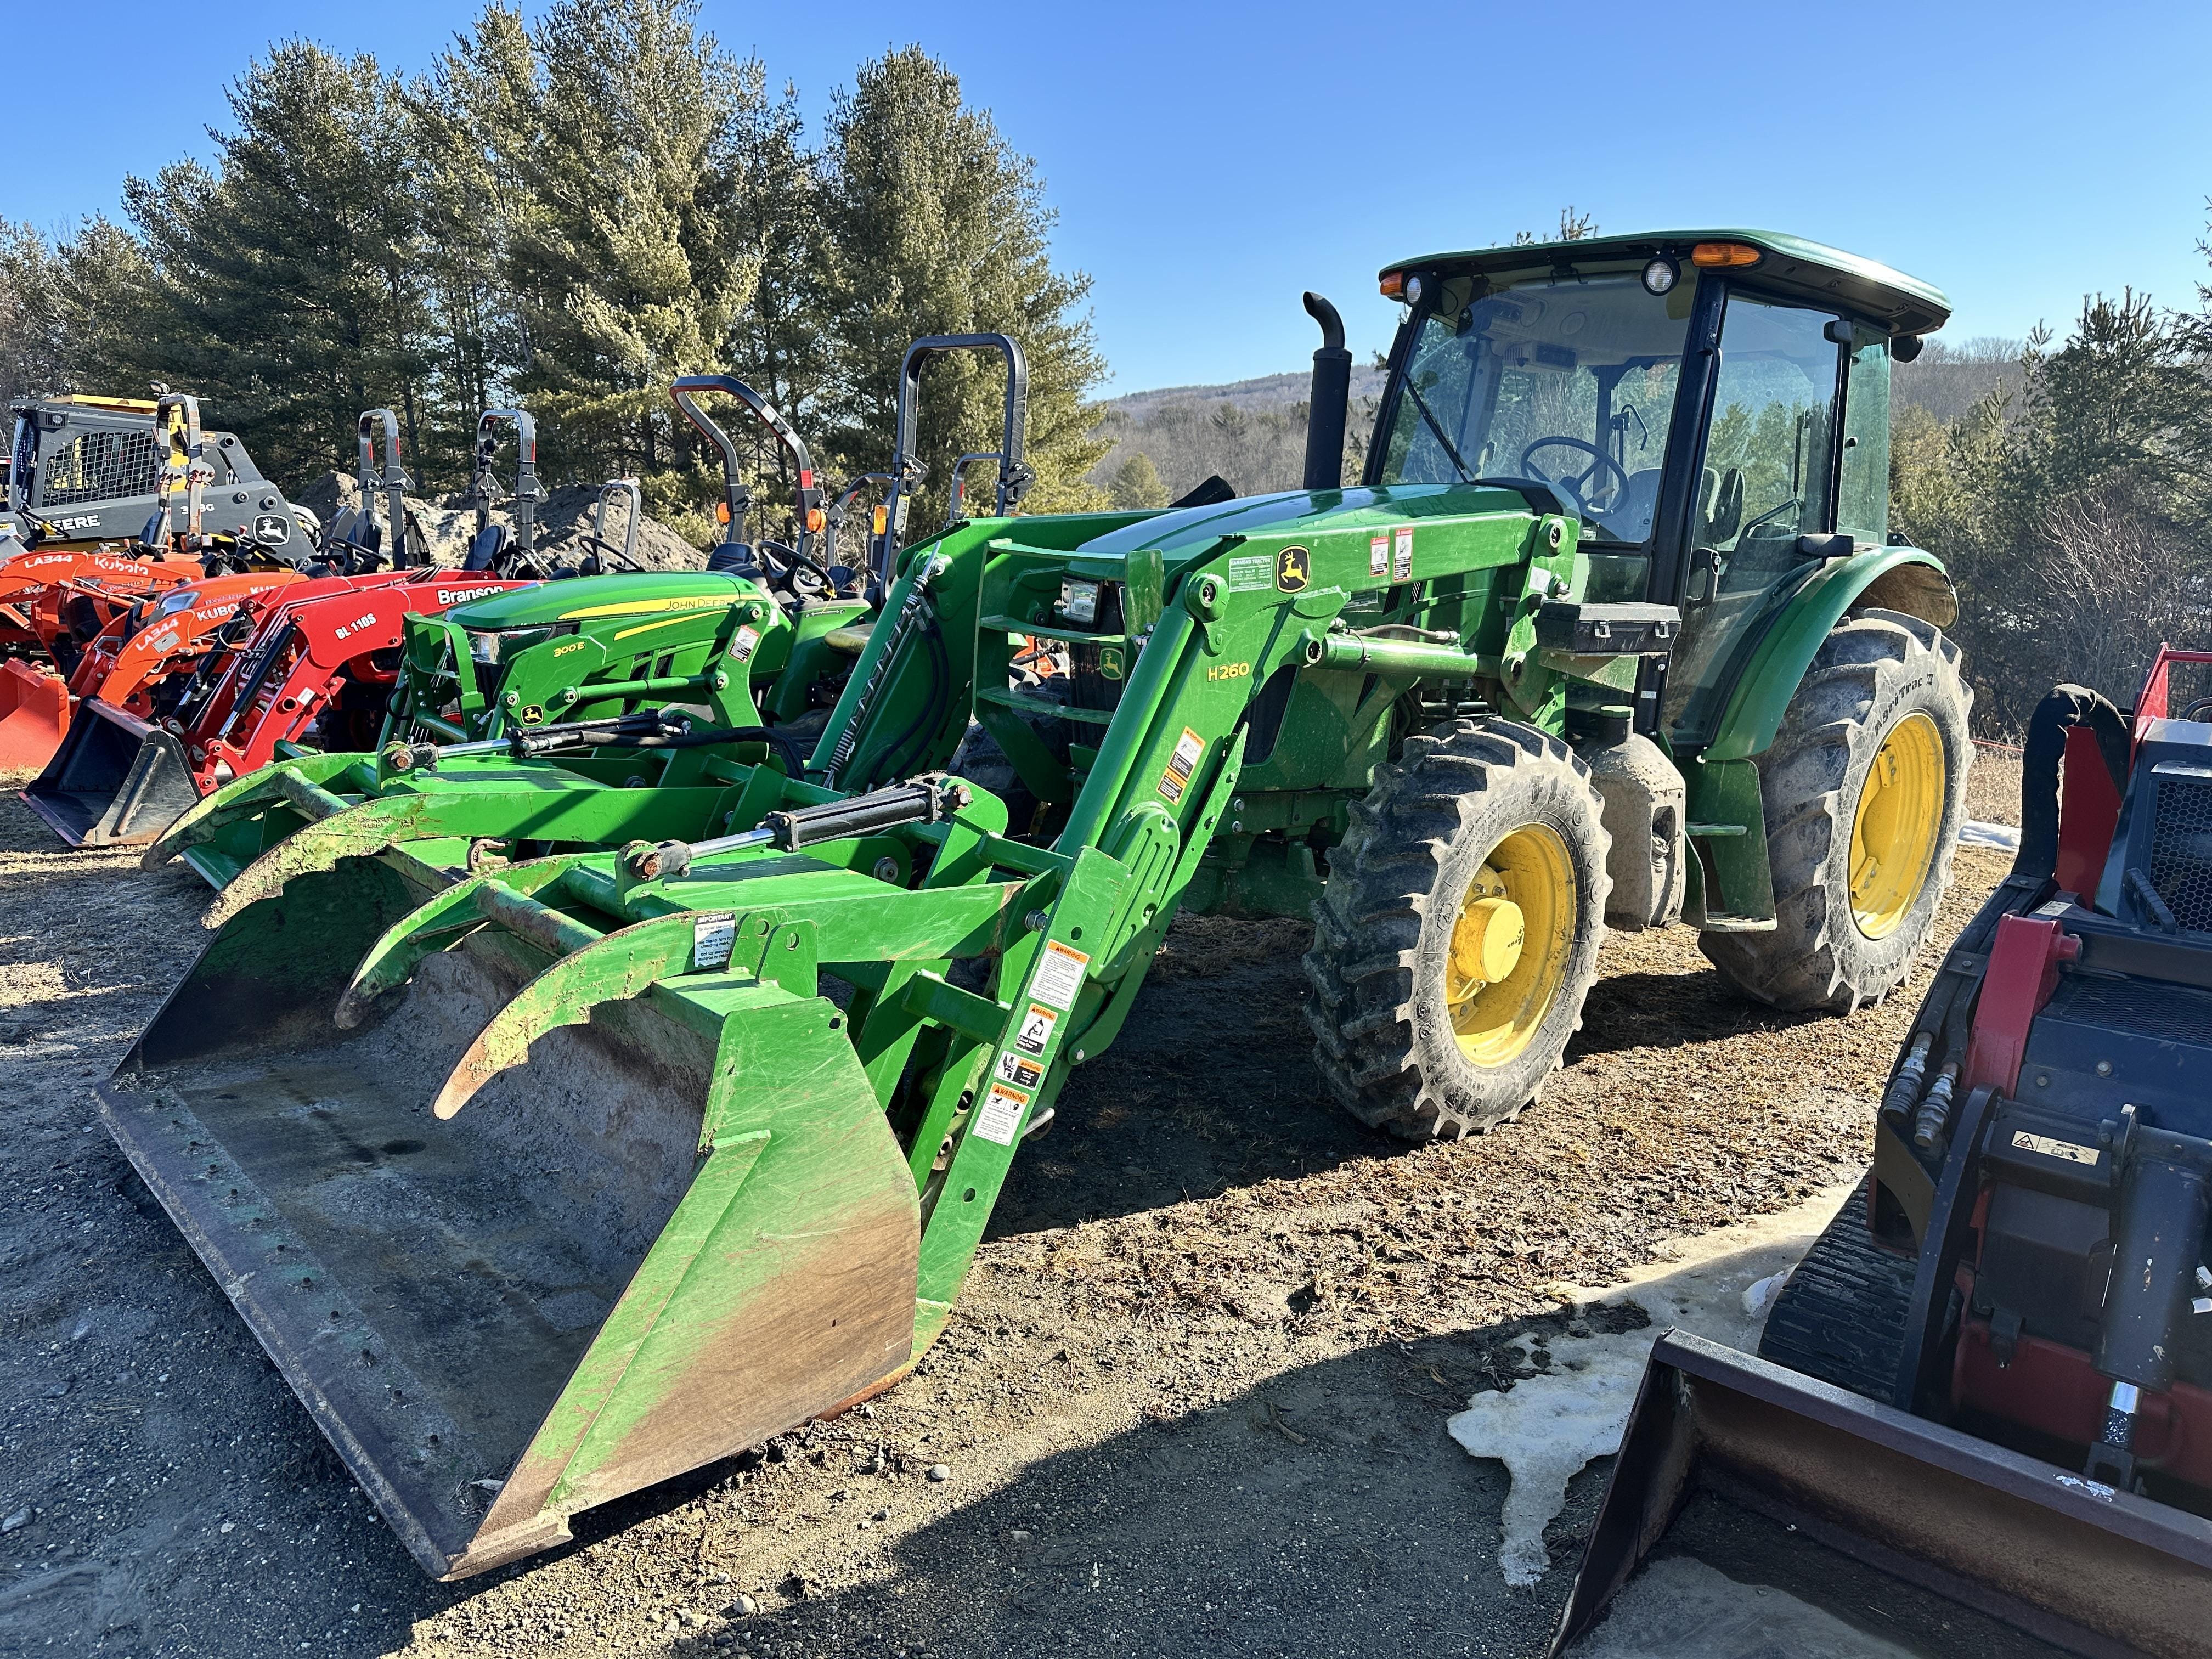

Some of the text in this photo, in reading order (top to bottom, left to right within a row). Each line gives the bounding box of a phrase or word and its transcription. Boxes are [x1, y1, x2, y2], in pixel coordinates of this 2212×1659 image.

[41, 515, 101, 532] EERE
[24, 555, 73, 568] LA344
[94, 556, 149, 575] Kubota
[437, 585, 504, 605] Branson
[196, 602, 239, 622] KUBO
[665, 601, 695, 610] JOHN
[136, 618, 178, 651] LA344
[335, 613, 376, 640] BL 110S
[1207, 662, 1250, 681] H260
[1875, 677, 1923, 737] AgriTrac
[697, 913, 732, 923] IMPORTANT
[1060, 946, 1080, 960] WARNING
[1036, 1008, 1054, 1019] WARNING
[1000, 1088, 1025, 1102] WARNING
